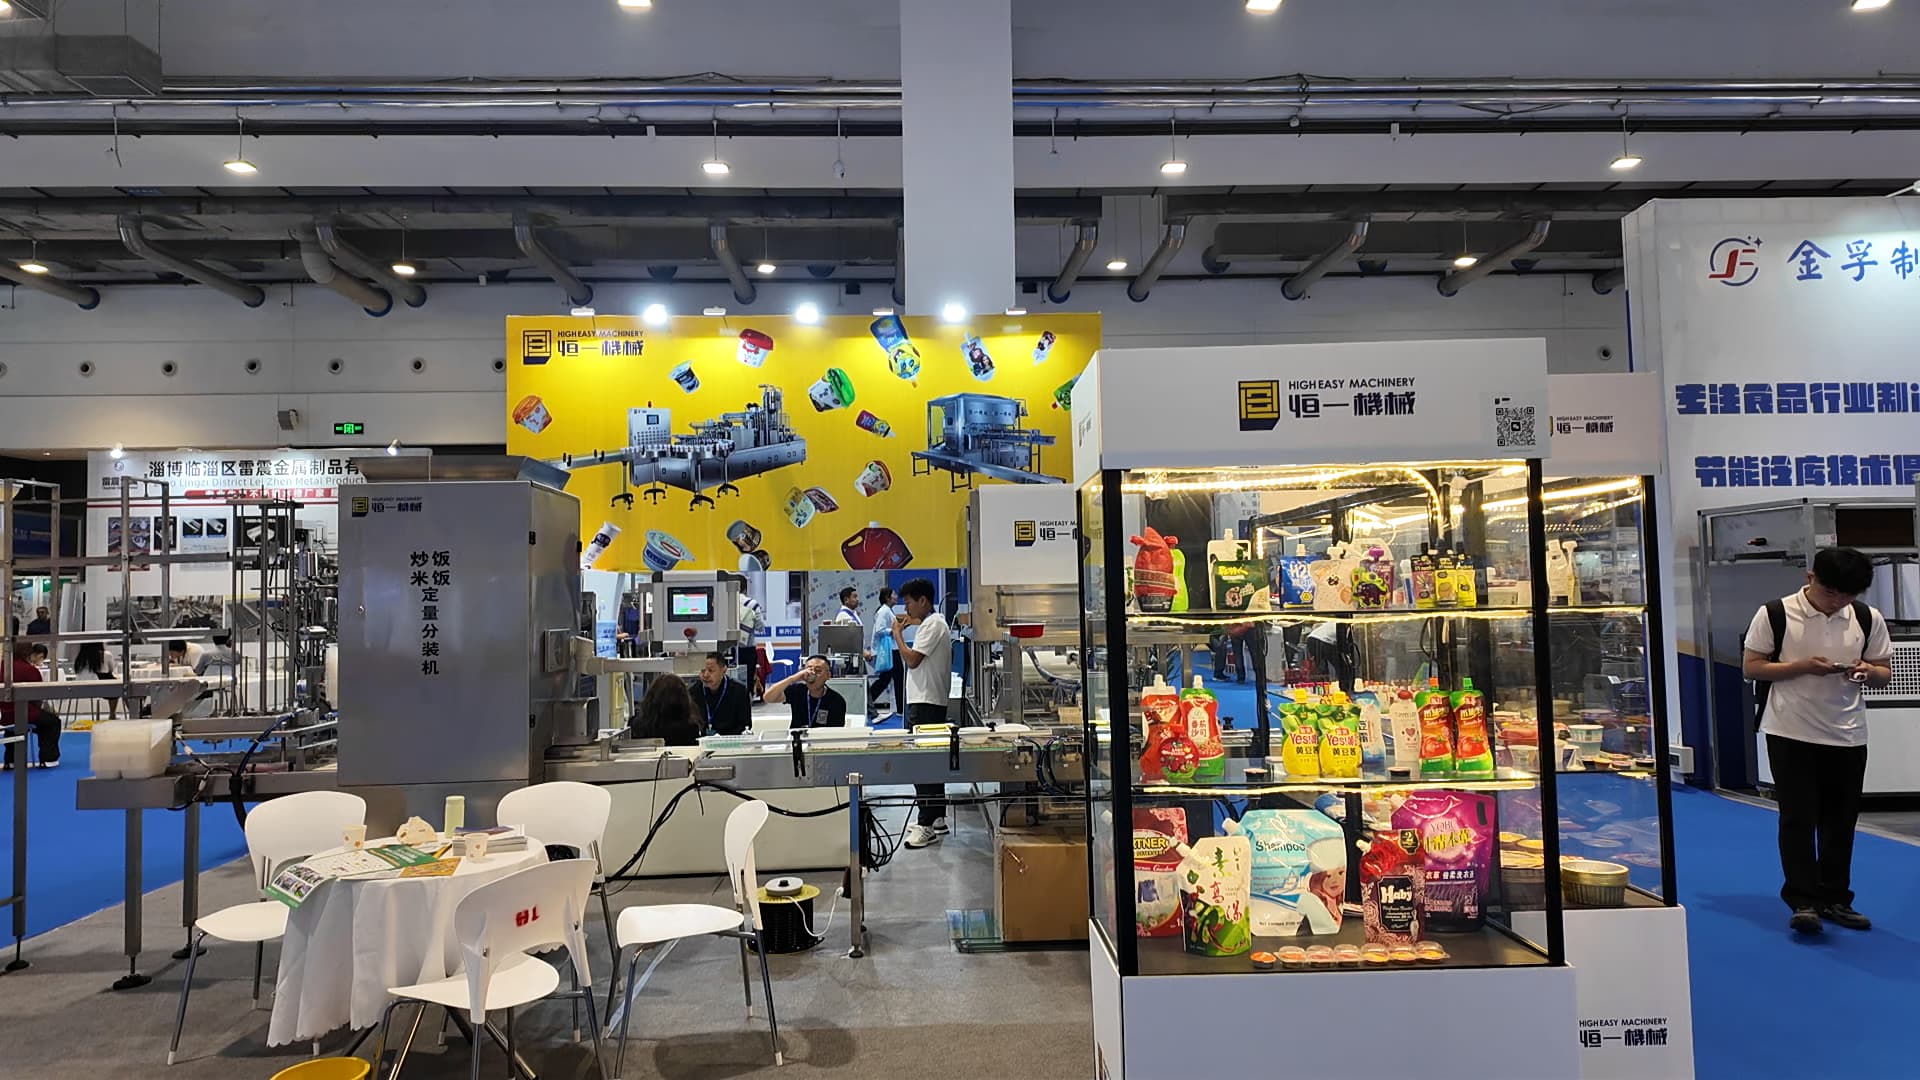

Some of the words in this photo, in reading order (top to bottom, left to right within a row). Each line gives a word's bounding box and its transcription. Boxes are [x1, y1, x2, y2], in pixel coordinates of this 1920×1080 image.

[1349, 377, 1416, 389] MACHINERY
[410, 551, 450, 568] 炒饭
[410, 570, 450, 587] 米饭
[421, 587, 440, 676] 定量分装机
[1380, 885, 1412, 904] Haby
[1620, 1017, 1667, 1026] MACHINERY
